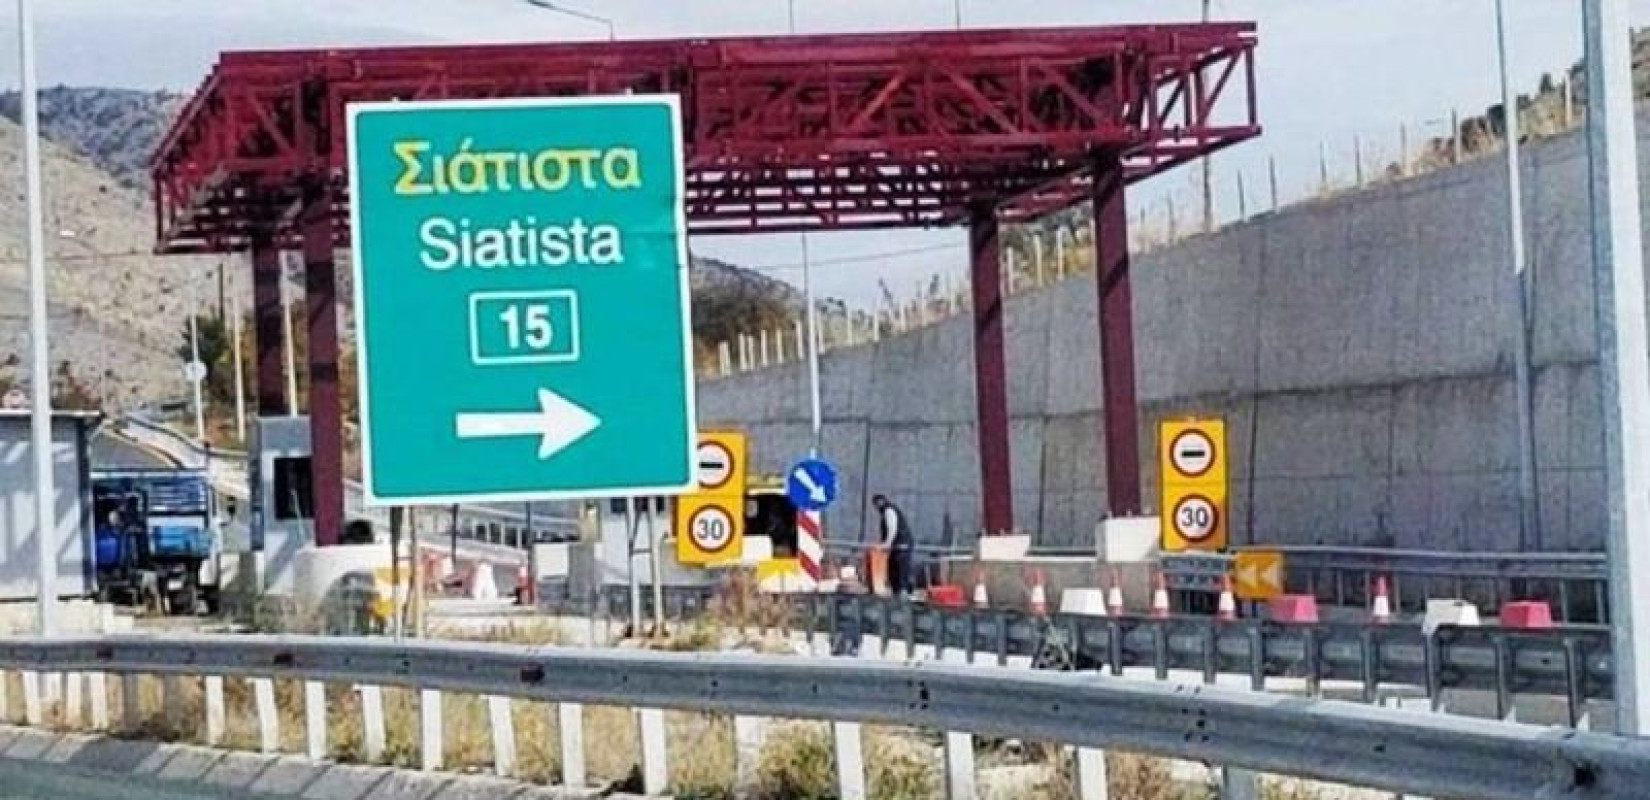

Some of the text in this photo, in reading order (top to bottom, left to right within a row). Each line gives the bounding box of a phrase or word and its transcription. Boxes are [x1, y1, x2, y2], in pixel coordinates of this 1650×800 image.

[393, 137, 641, 195] Σιάτιστα
[420, 217, 624, 270] Siatista
[500, 304, 553, 349] 15
[697, 519, 725, 540] 30
[1182, 507, 1208, 527] 30
